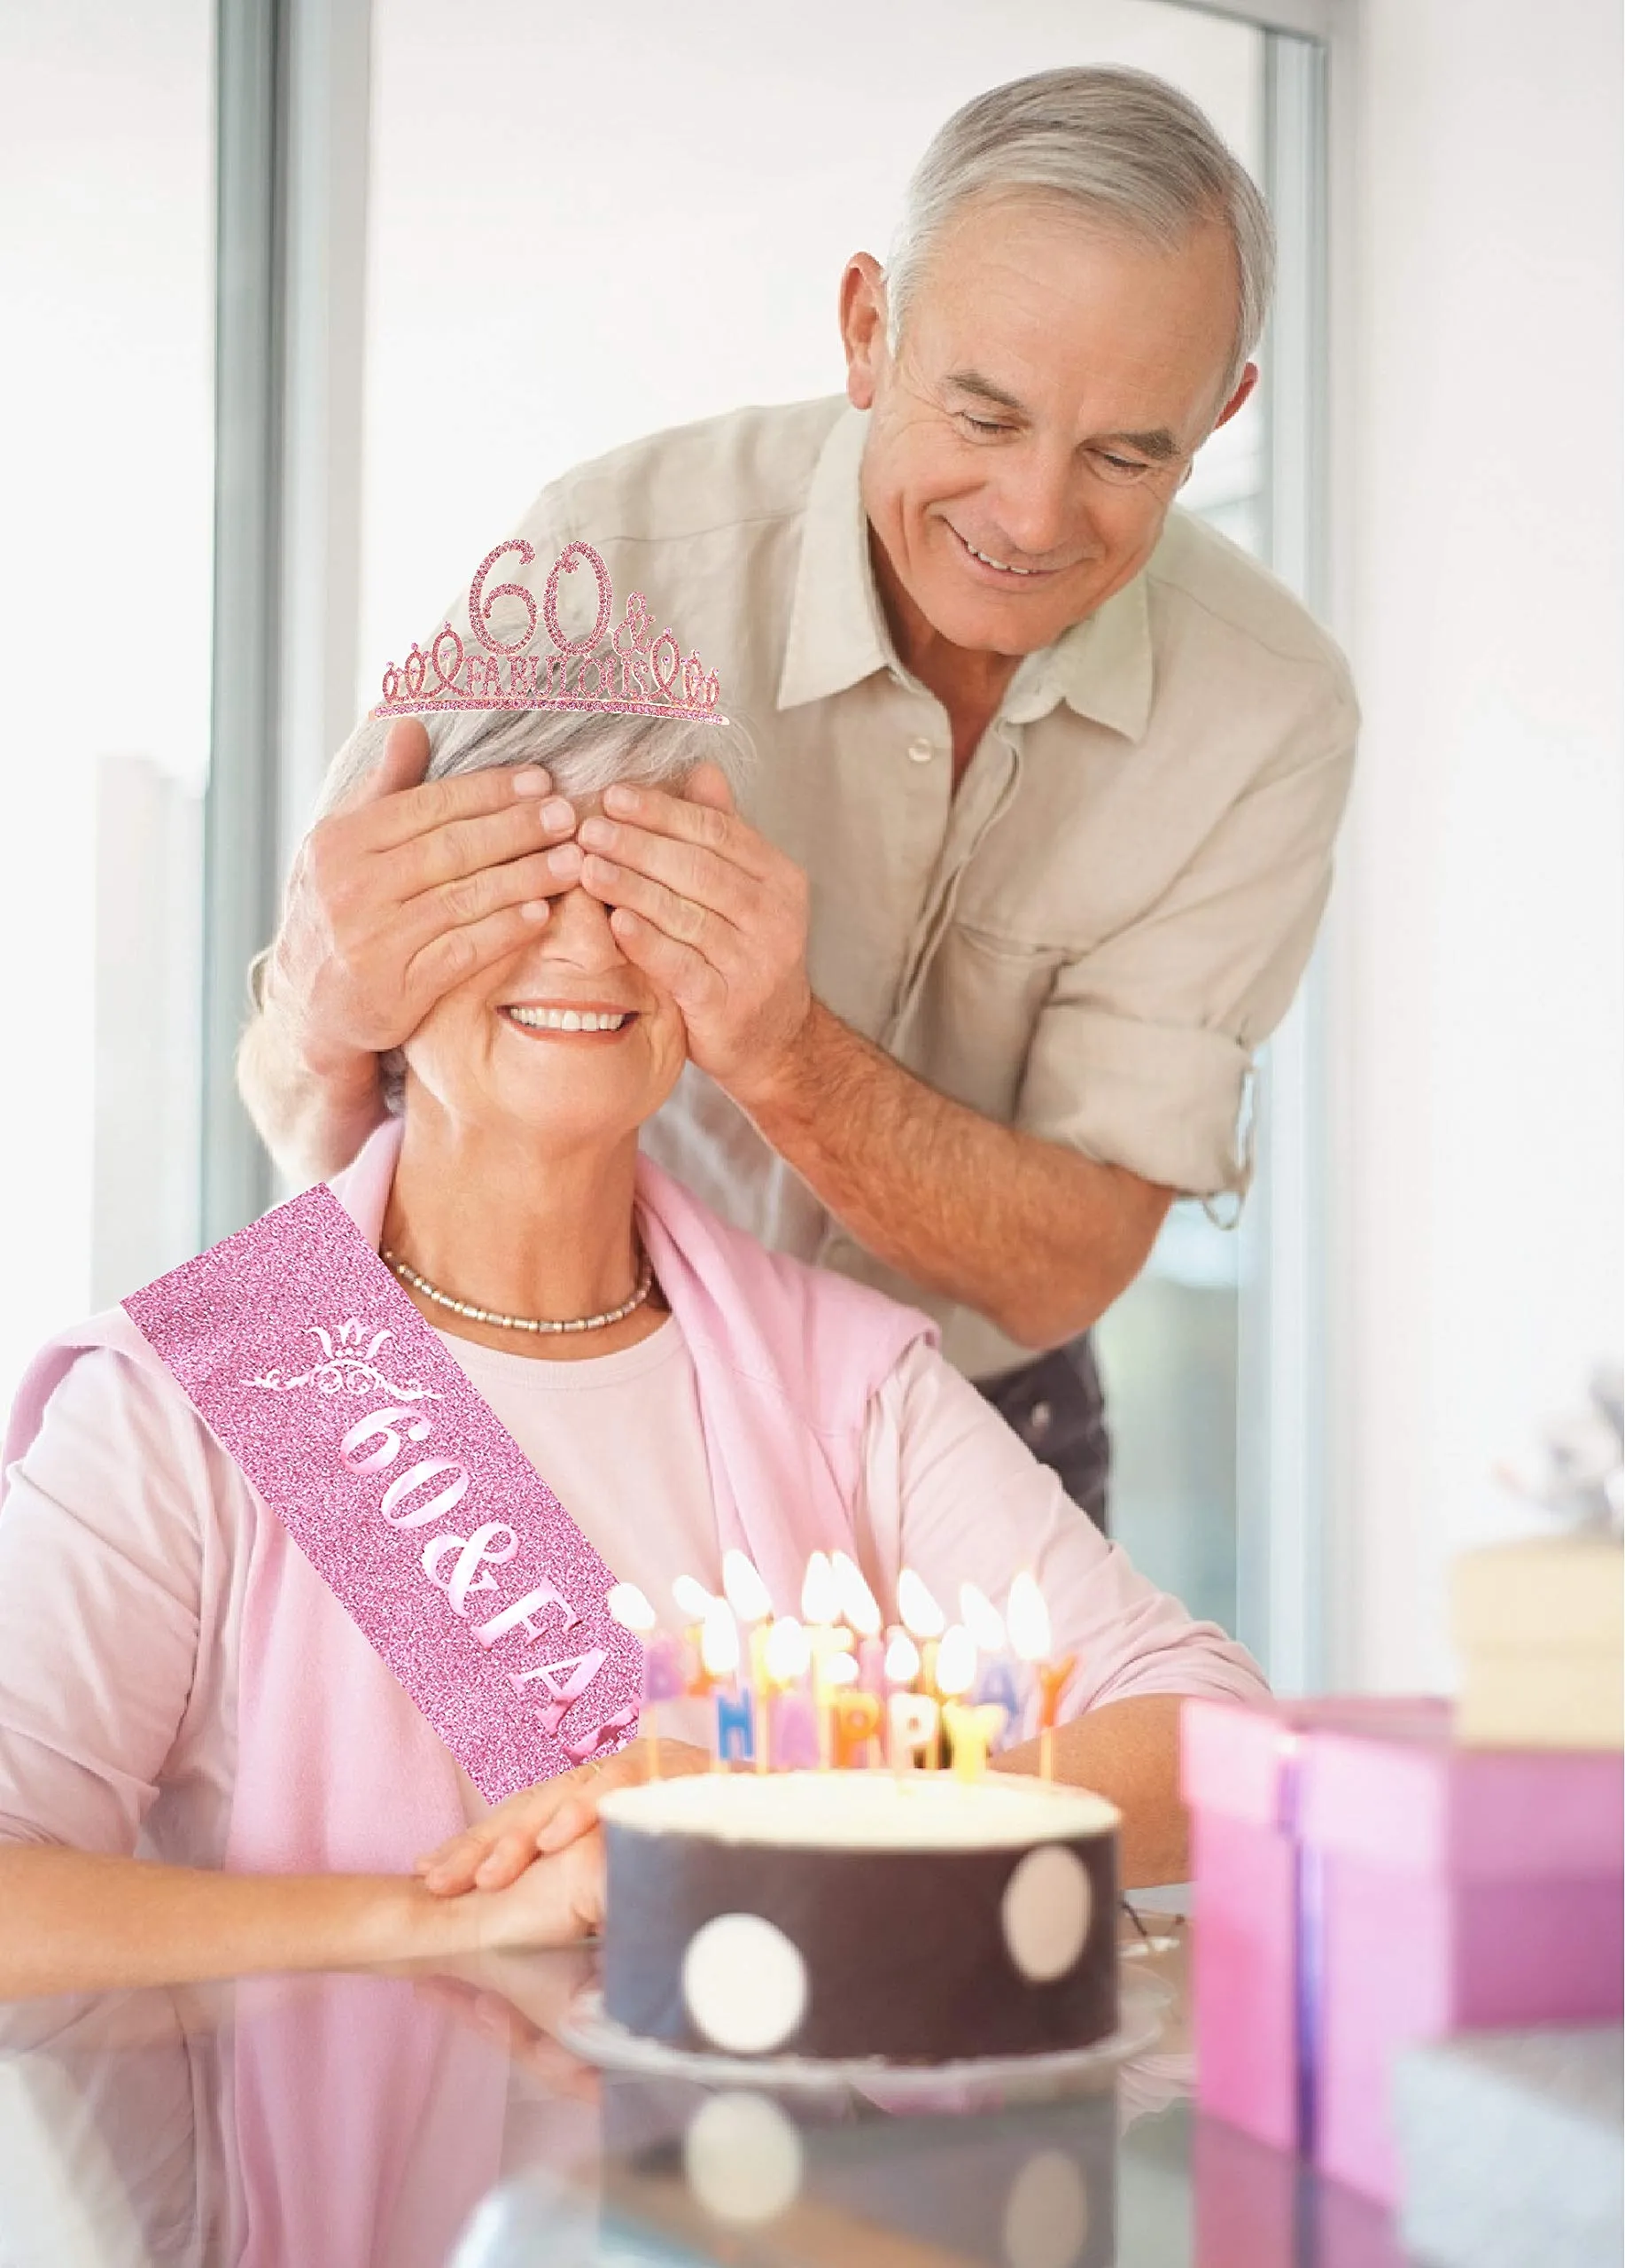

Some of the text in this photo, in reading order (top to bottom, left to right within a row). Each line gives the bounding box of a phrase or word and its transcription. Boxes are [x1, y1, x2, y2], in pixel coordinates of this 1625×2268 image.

[469, 539, 613, 656] 60
[463, 655, 649, 703] FABULOUS
[716, 1686, 1007, 1779] HAPPY
